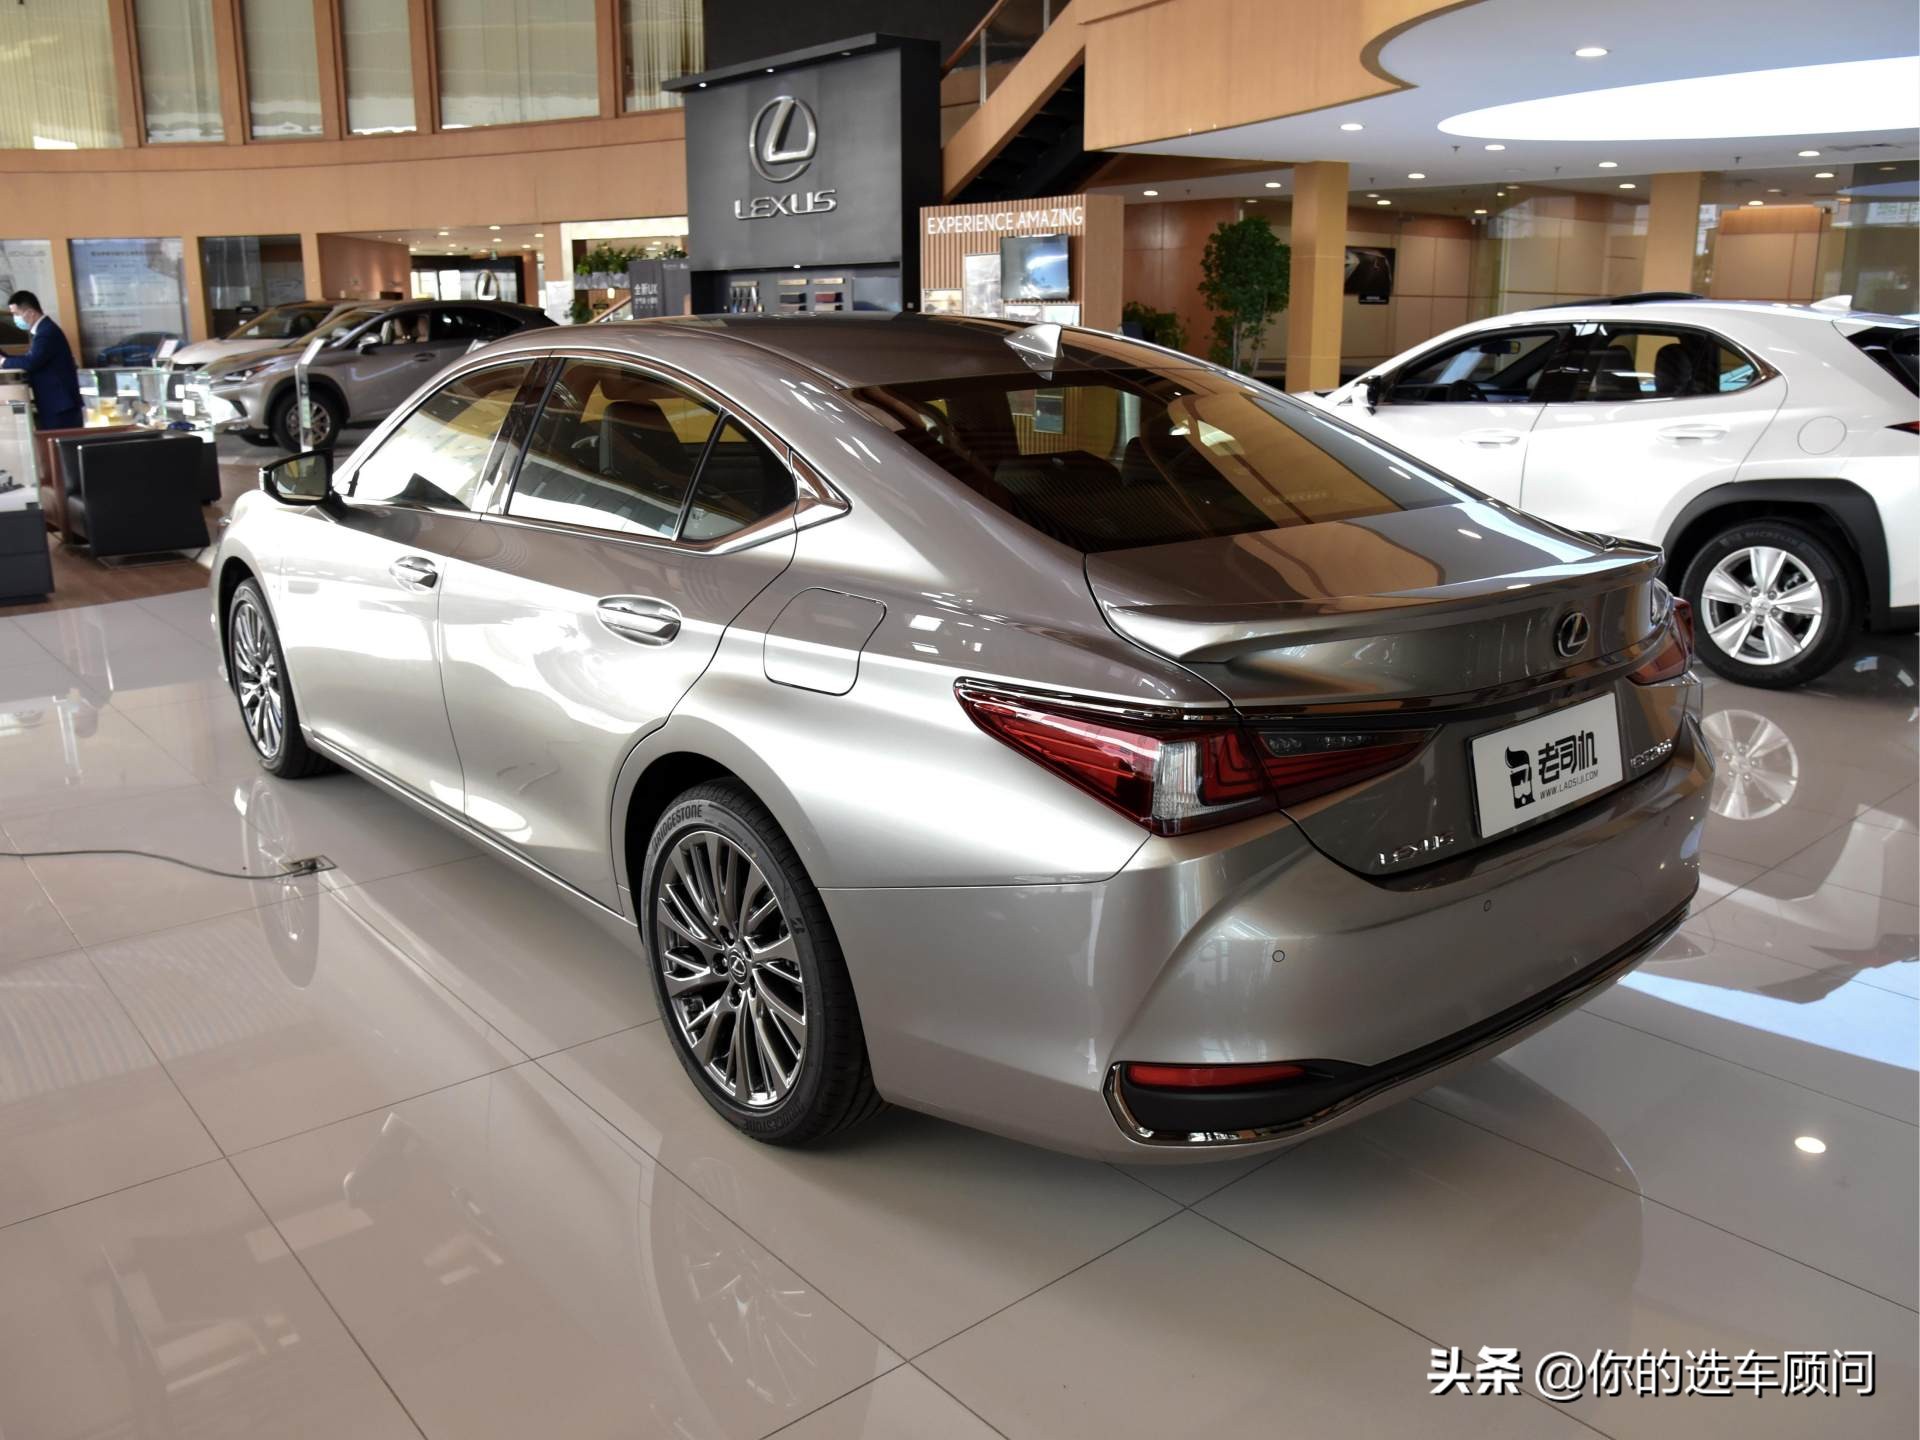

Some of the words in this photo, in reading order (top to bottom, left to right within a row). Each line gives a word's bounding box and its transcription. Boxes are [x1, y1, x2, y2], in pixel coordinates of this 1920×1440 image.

[734, 188, 837, 220] LEXUS
[927, 212, 1014, 235] EXPERIENCE
[1016, 206, 1085, 230] AMAZING
[1538, 730, 1598, 785] 老司机
[1539, 770, 1599, 800] WWW.LAOSIJI.COM
[1379, 832, 1456, 865] LEXUS
